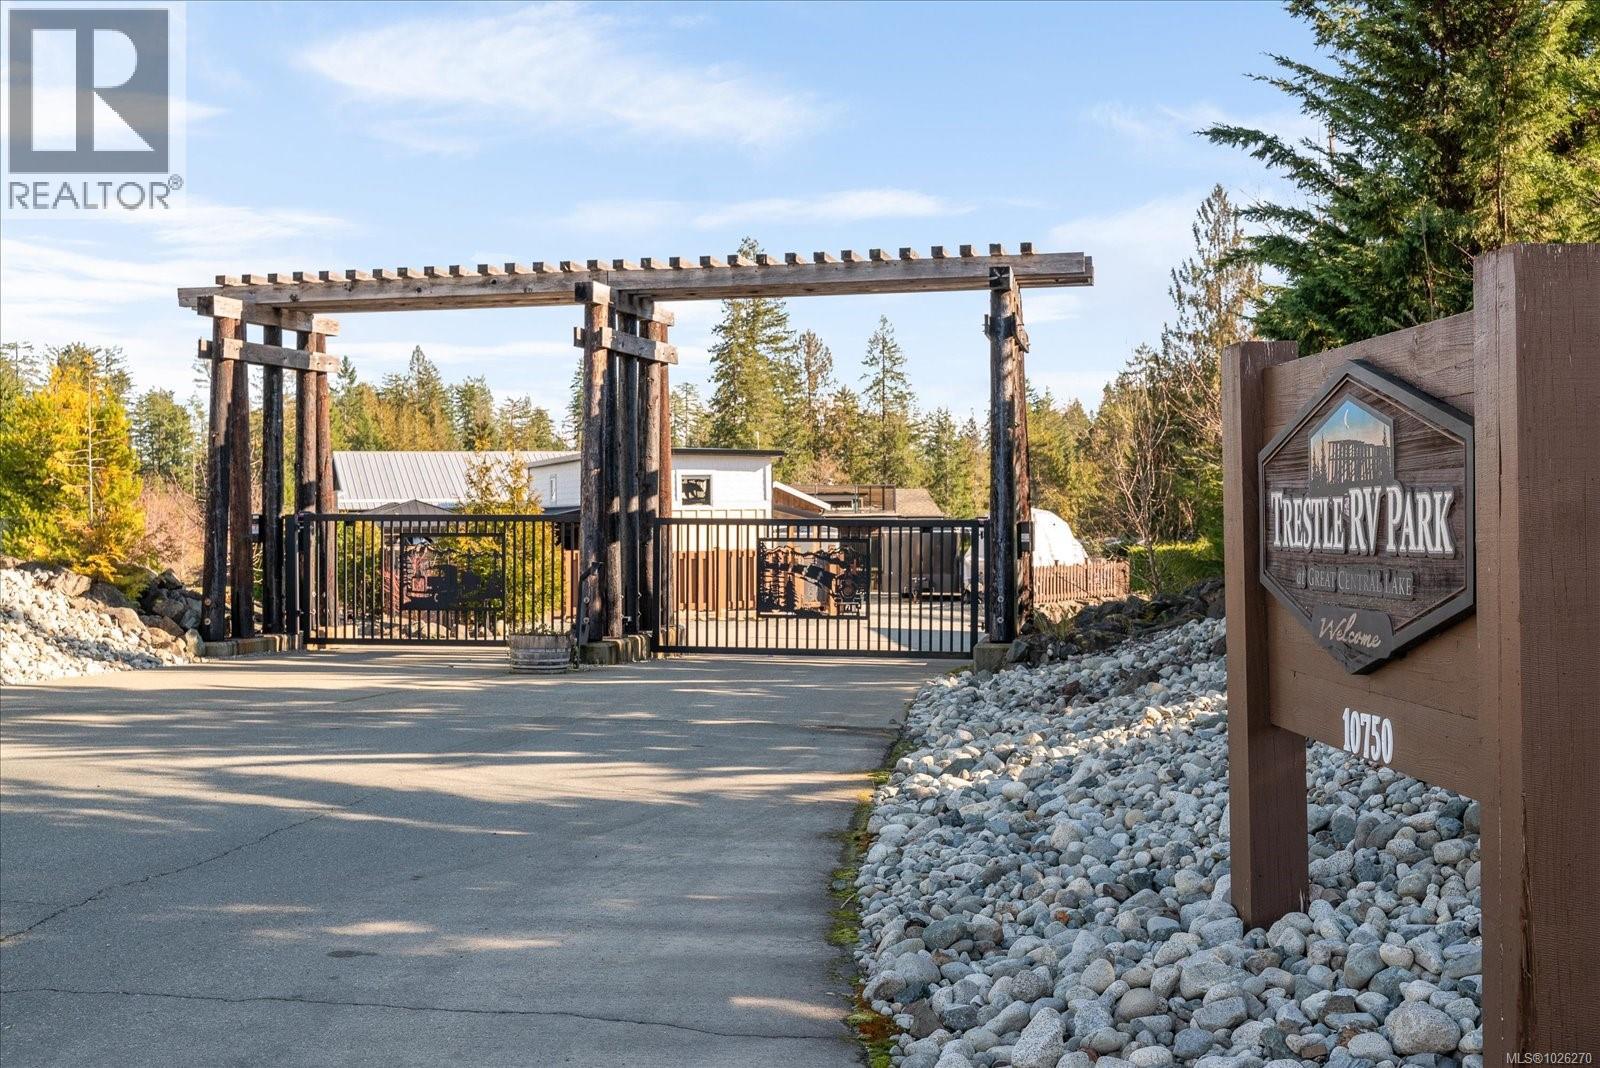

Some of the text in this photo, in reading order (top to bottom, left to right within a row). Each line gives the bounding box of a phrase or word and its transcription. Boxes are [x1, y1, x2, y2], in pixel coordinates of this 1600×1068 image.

[1271, 484, 1454, 555] TRESTLE RV PARK
[1296, 567, 1413, 596] at GREAT CENTRAL LAKE
[1319, 613, 1382, 648] Welcome
[1342, 707, 1393, 764] 10750
